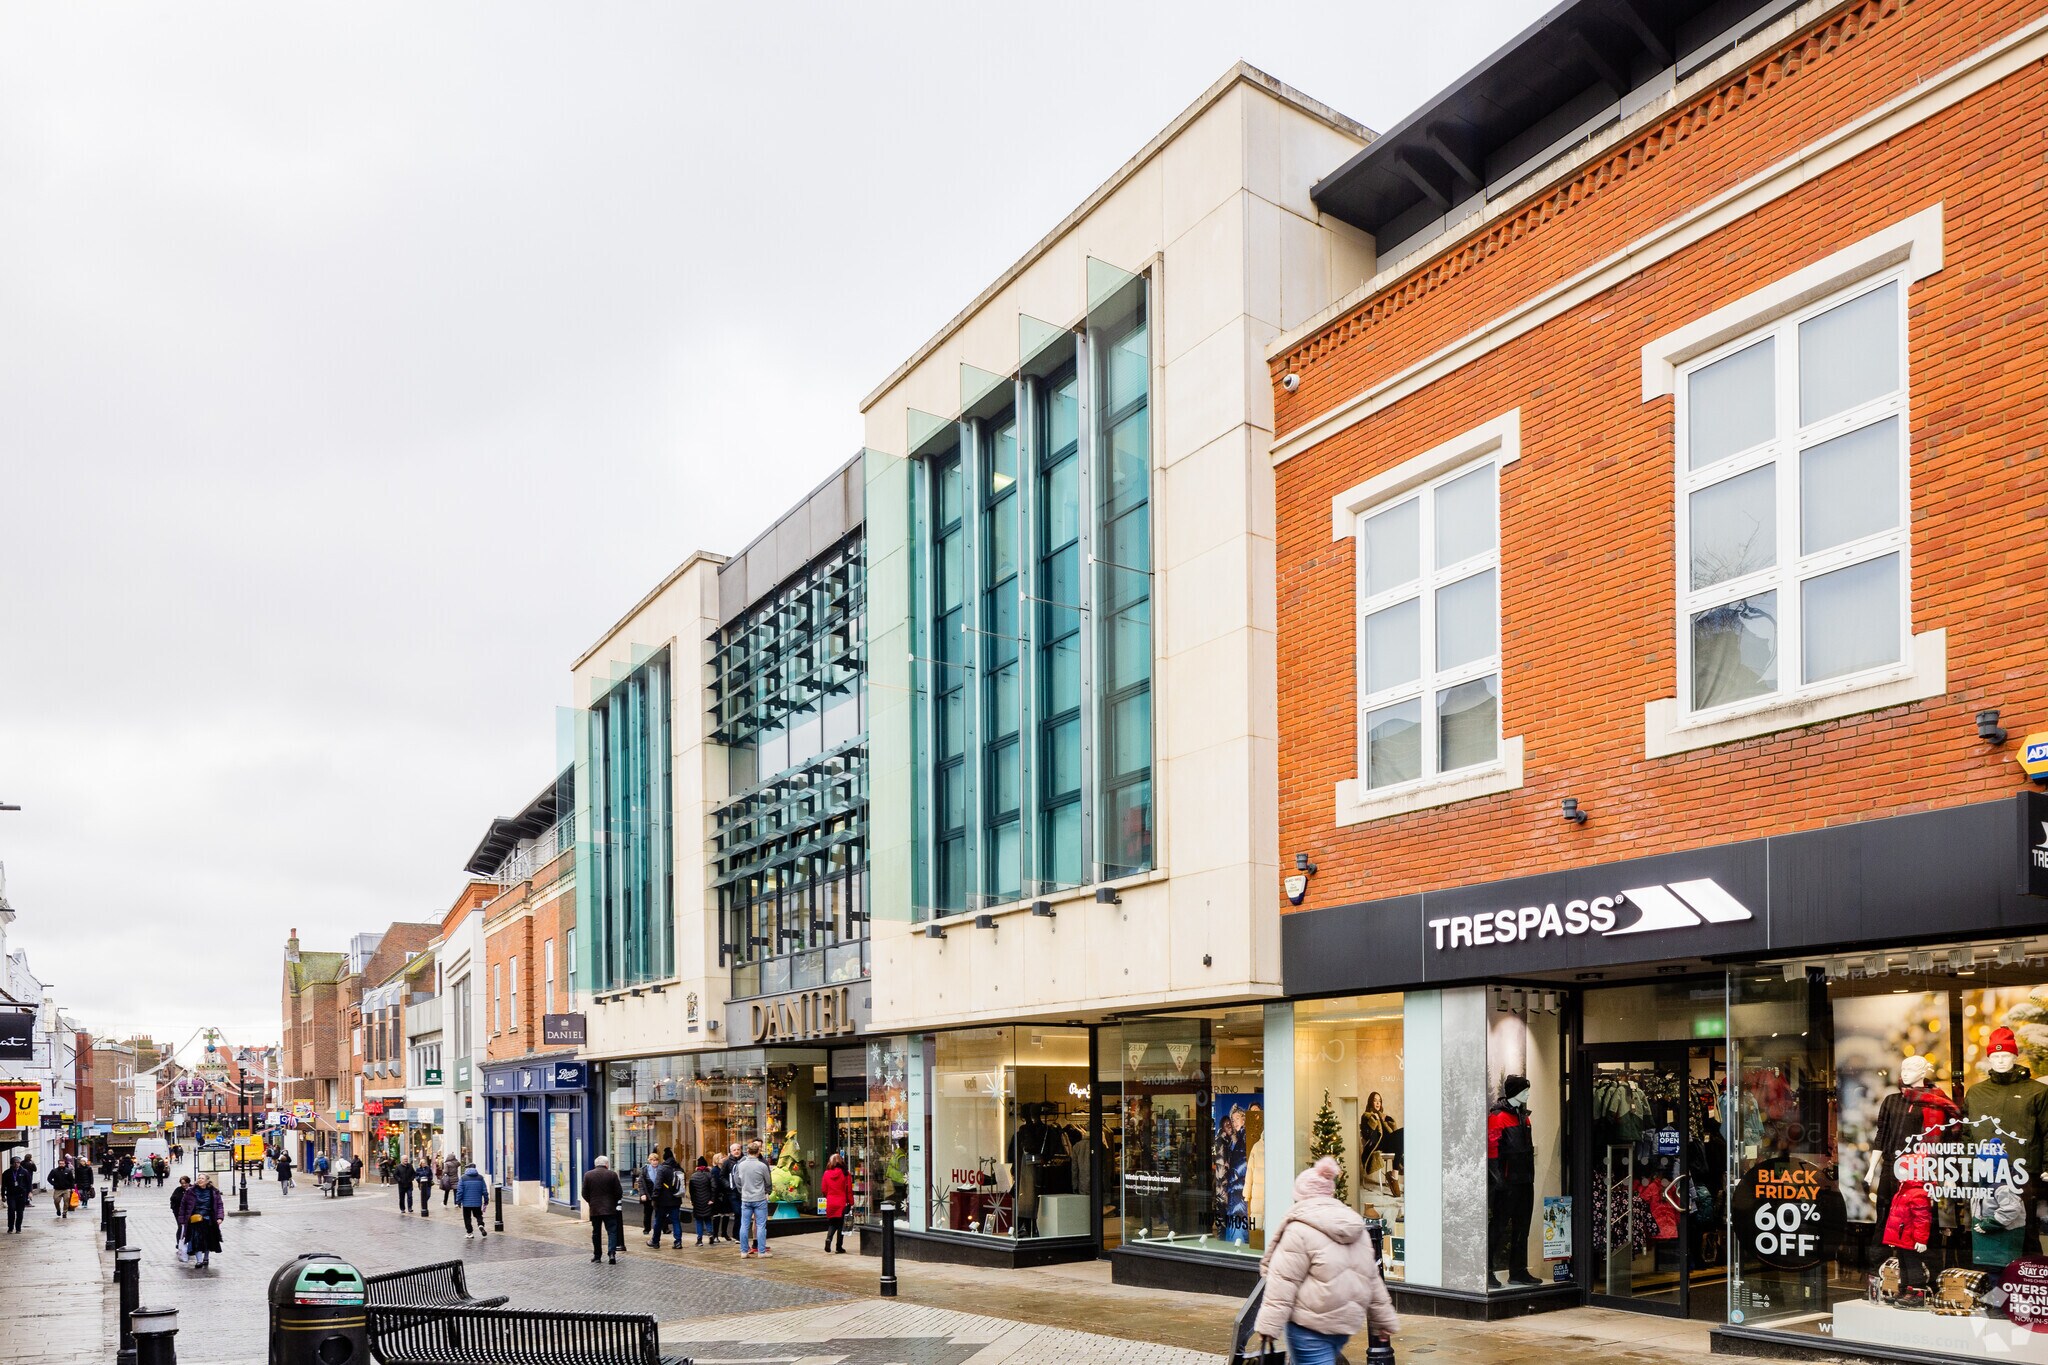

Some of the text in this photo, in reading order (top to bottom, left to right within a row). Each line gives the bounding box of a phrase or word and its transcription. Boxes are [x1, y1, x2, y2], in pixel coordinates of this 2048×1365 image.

[752, 987, 855, 1042] DANIEL
[547, 1031, 584, 1039] DANIEL
[1913, 1139, 2007, 1155] CONQUER EVERY
[952, 1169, 984, 1185] HUGO
[1758, 1169, 1817, 1184] BLACK
[1893, 1157, 2029, 1194] CHRISTMAS
[1755, 1185, 1820, 1200] FRIDAY
[1923, 1183, 1994, 1202] ADVENTURE
[1755, 1202, 1821, 1232] 60%
[2018, 1265, 2044, 1278] STAY
